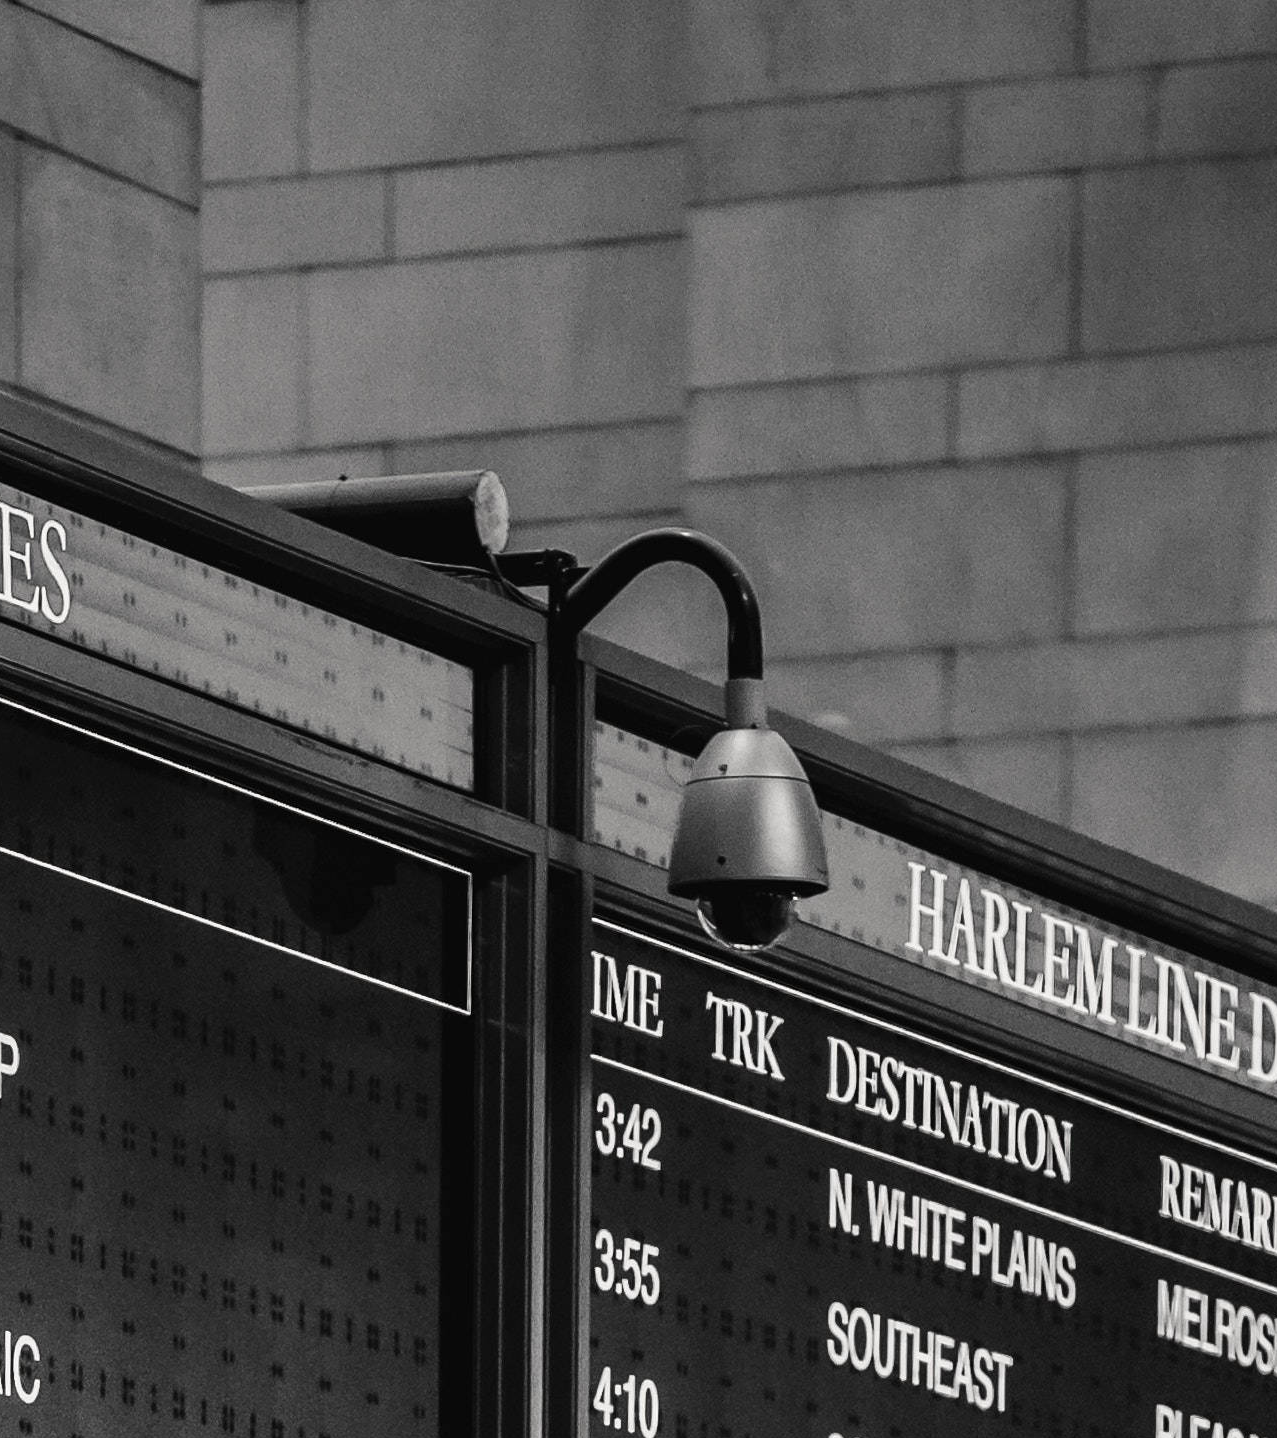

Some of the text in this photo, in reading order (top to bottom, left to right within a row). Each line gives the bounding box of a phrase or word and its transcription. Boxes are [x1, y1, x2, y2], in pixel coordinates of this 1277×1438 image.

[905, 862, 1117, 1023] HARLEM
[1124, 946, 1239, 1069] LINE
[706, 992, 785, 1080] TRK
[596, 1093, 661, 1170] 3:42
[827, 1037, 1073, 1182] DESTINATION
[595, 1229, 659, 1305] 3:55
[829, 1168, 1076, 1307] N. WHITE PLAINS
[594, 1367, 658, 1438] 4:10
[827, 1302, 1013, 1411] SOUTHEAST
